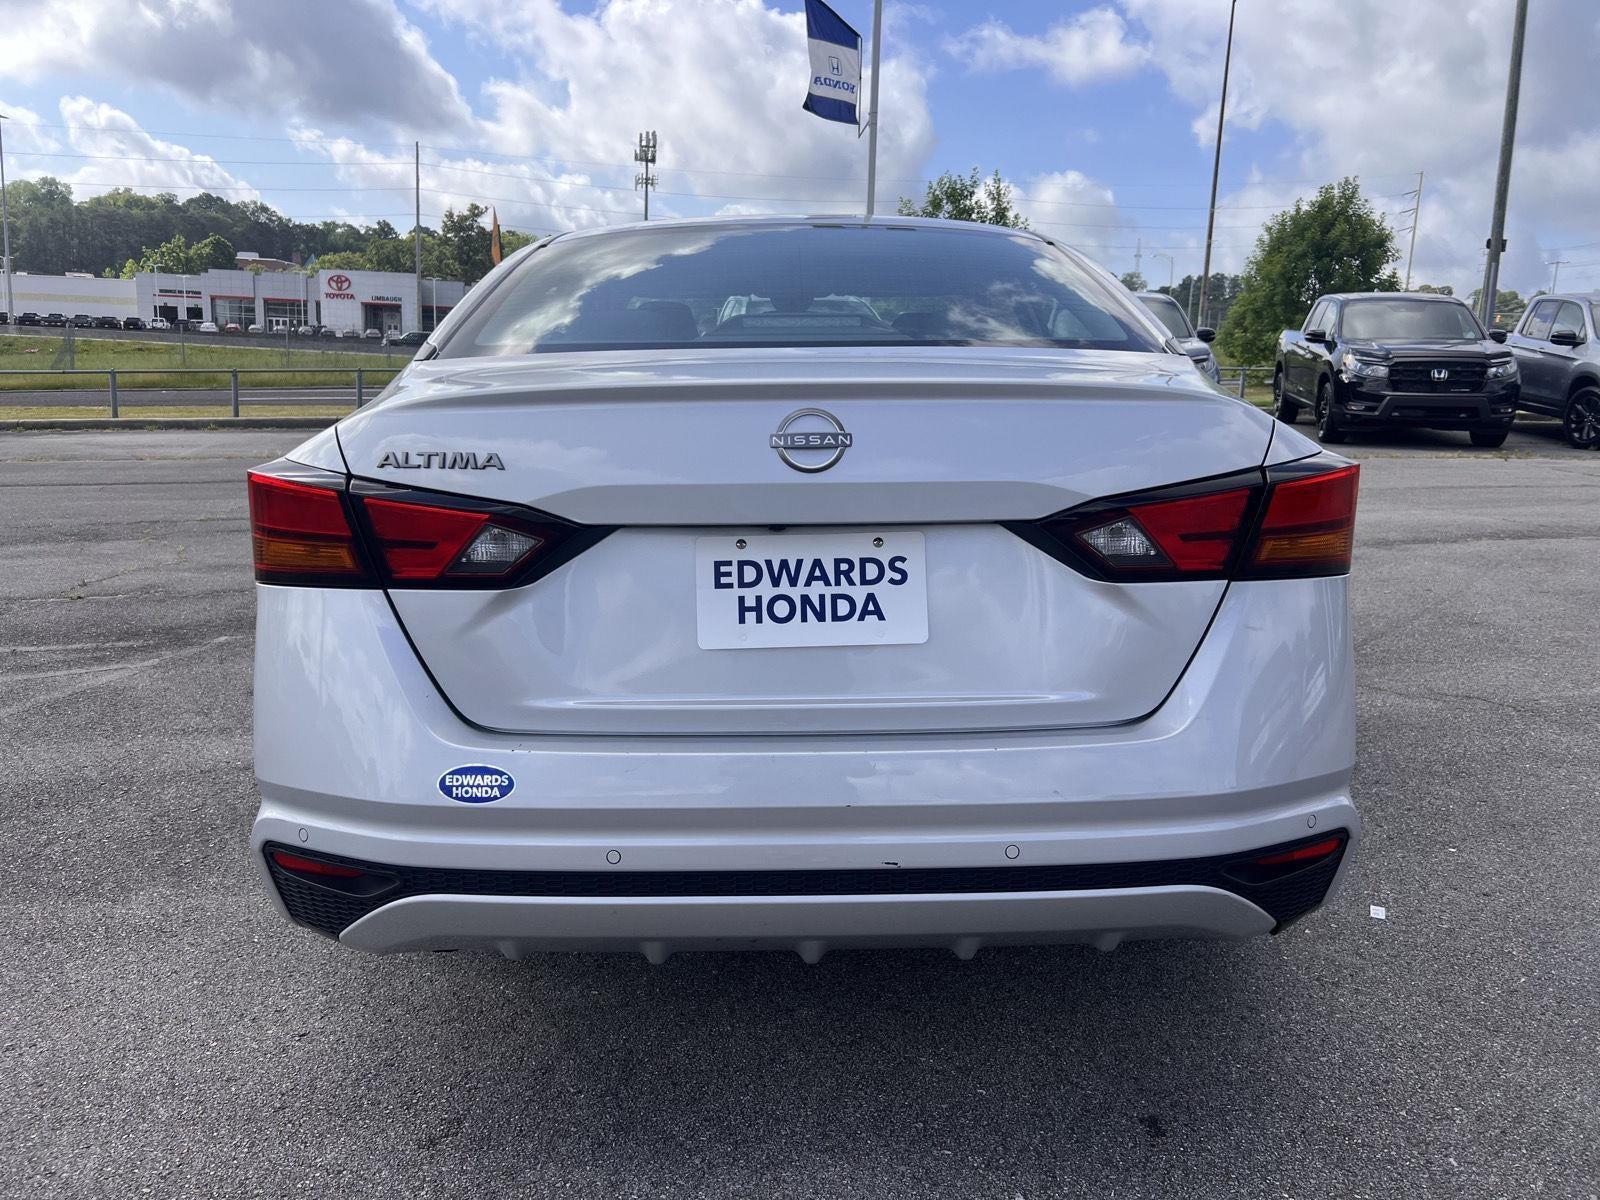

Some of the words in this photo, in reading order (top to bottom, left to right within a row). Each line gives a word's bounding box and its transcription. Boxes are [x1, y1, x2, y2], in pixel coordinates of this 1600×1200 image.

[324, 292, 355, 301] TOYOTA
[772, 435, 850, 446] NISSAN
[377, 451, 506, 471] ALTIMA
[713, 555, 909, 590] EDWARDS
[737, 592, 886, 625] HONDA
[445, 774, 509, 786] EDWARDS
[452, 786, 501, 798] HONDA
